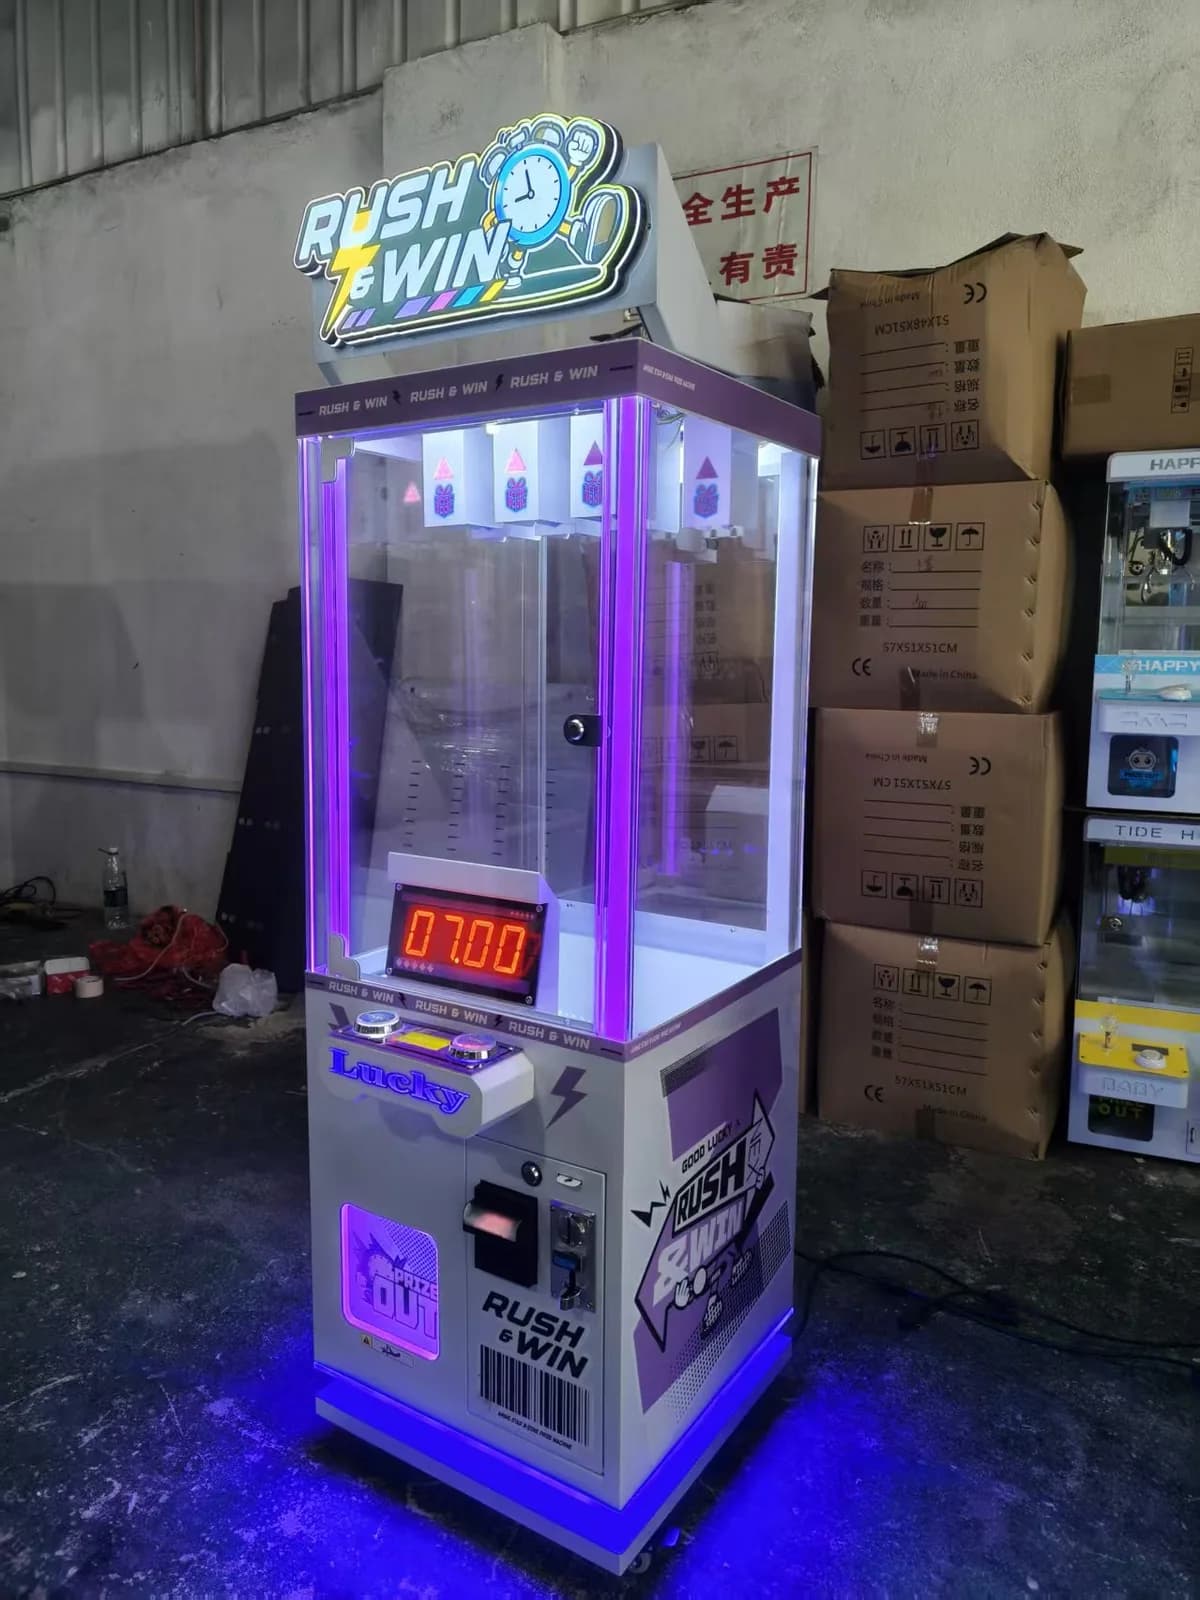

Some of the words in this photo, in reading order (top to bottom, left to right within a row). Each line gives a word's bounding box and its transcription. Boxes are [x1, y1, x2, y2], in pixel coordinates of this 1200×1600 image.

[299, 161, 475, 260] RUSH
[682, 176, 800, 226] 全生产
[350, 265, 374, 300] &
[383, 221, 512, 303] WIN
[719, 243, 798, 286] 有责
[410, 388, 445, 403] RUSH
[449, 386, 457, 396] &
[462, 381, 488, 395] WIN
[510, 372, 548, 389] RUSH
[553, 370, 563, 382] &
[568, 365, 598, 380] WIN
[319, 402, 349, 416] RUSH
[353, 400, 361, 411] &
[364, 396, 388, 409] WIN
[1138, 660, 1200, 672] HAPPY
[1114, 824, 1163, 838] TIDE
[405, 910, 526, 974] 07.00
[328, 980, 358, 996] RUSH
[361, 988, 368, 997] &
[372, 990, 394, 1004] WIN
[415, 999, 447, 1016] RUSH
[451, 1008, 459, 1018] &
[463, 1011, 488, 1025] WIN
[508, 1021, 545, 1039] RUSH
[549, 1031, 558, 1042] &
[563, 1035, 590, 1050] WIN
[328, 1046, 471, 1115] Lucky
[682, 1143, 705, 1174] GOOD
[677, 1137, 747, 1226] RUSH
[689, 1200, 743, 1273] WIN
[394, 1266, 438, 1300] PRIZE
[373, 1274, 438, 1340] OUT
[482, 1291, 585, 1348] RUSH
[499, 1328, 513, 1343] &
[517, 1330, 589, 1378] WIN
